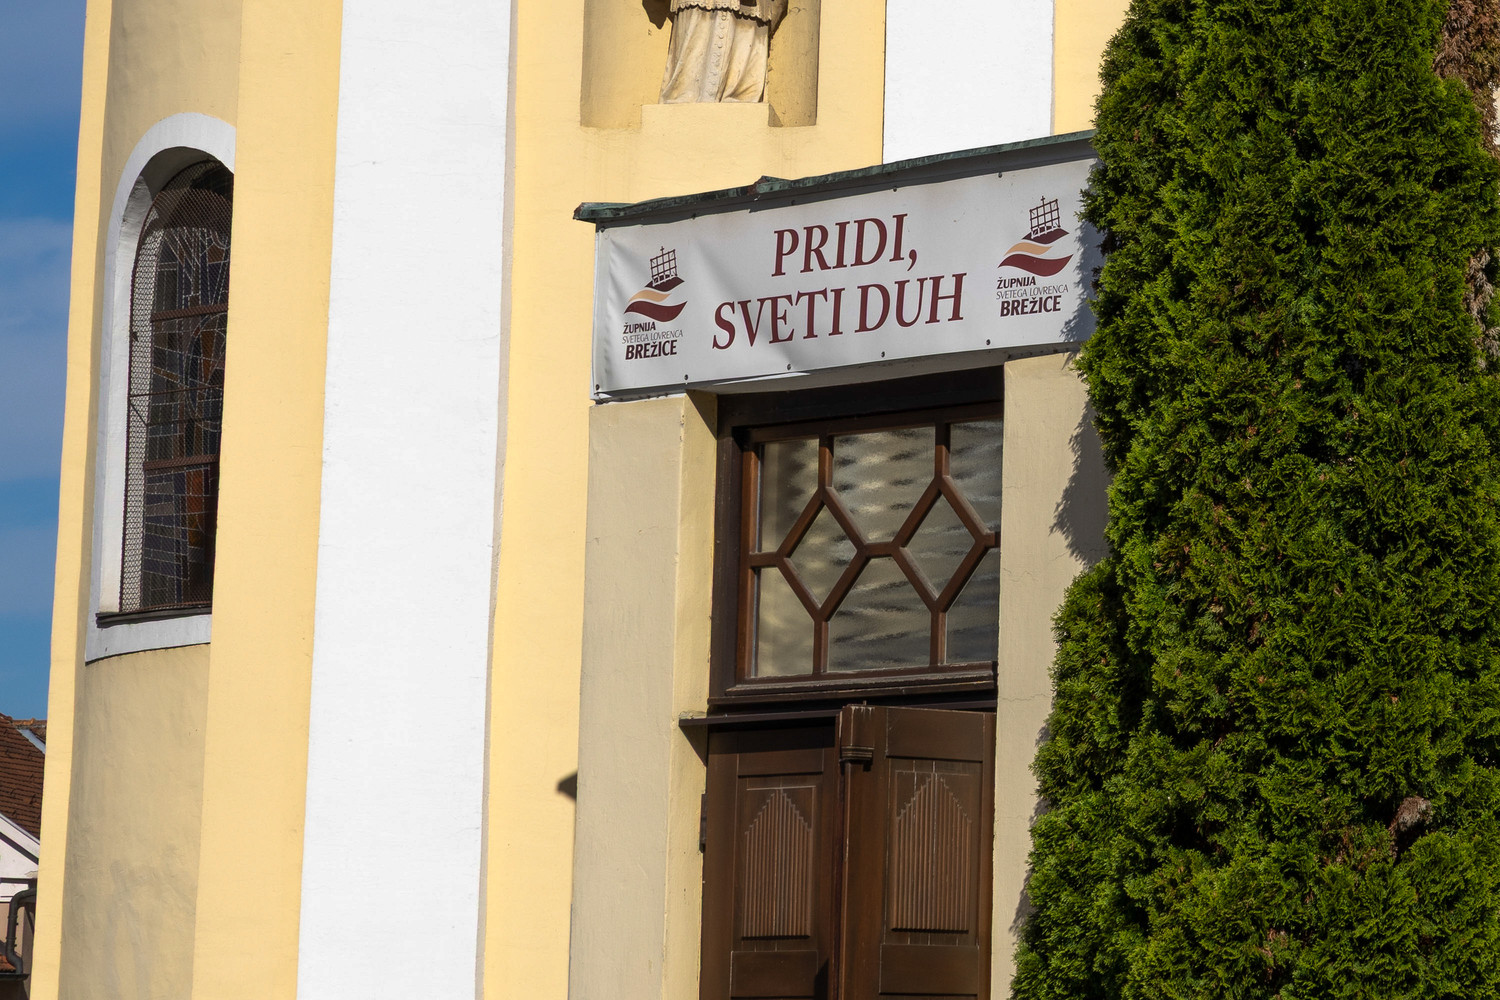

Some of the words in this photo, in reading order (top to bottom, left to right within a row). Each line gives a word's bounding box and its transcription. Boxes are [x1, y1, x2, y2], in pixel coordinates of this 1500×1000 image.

[771, 213, 917, 277] PRIDI,
[996, 288, 1028, 300] SVETEGA
[1029, 284, 1069, 297] LOVRENCA
[997, 276, 1036, 290] ŽUPNIJA
[712, 287, 845, 350] SVETI
[854, 272, 967, 333] DUH
[1000, 295, 1062, 317] BREŽICE
[622, 333, 649, 344] SVETEGA
[625, 339, 678, 360] BREŽICE
